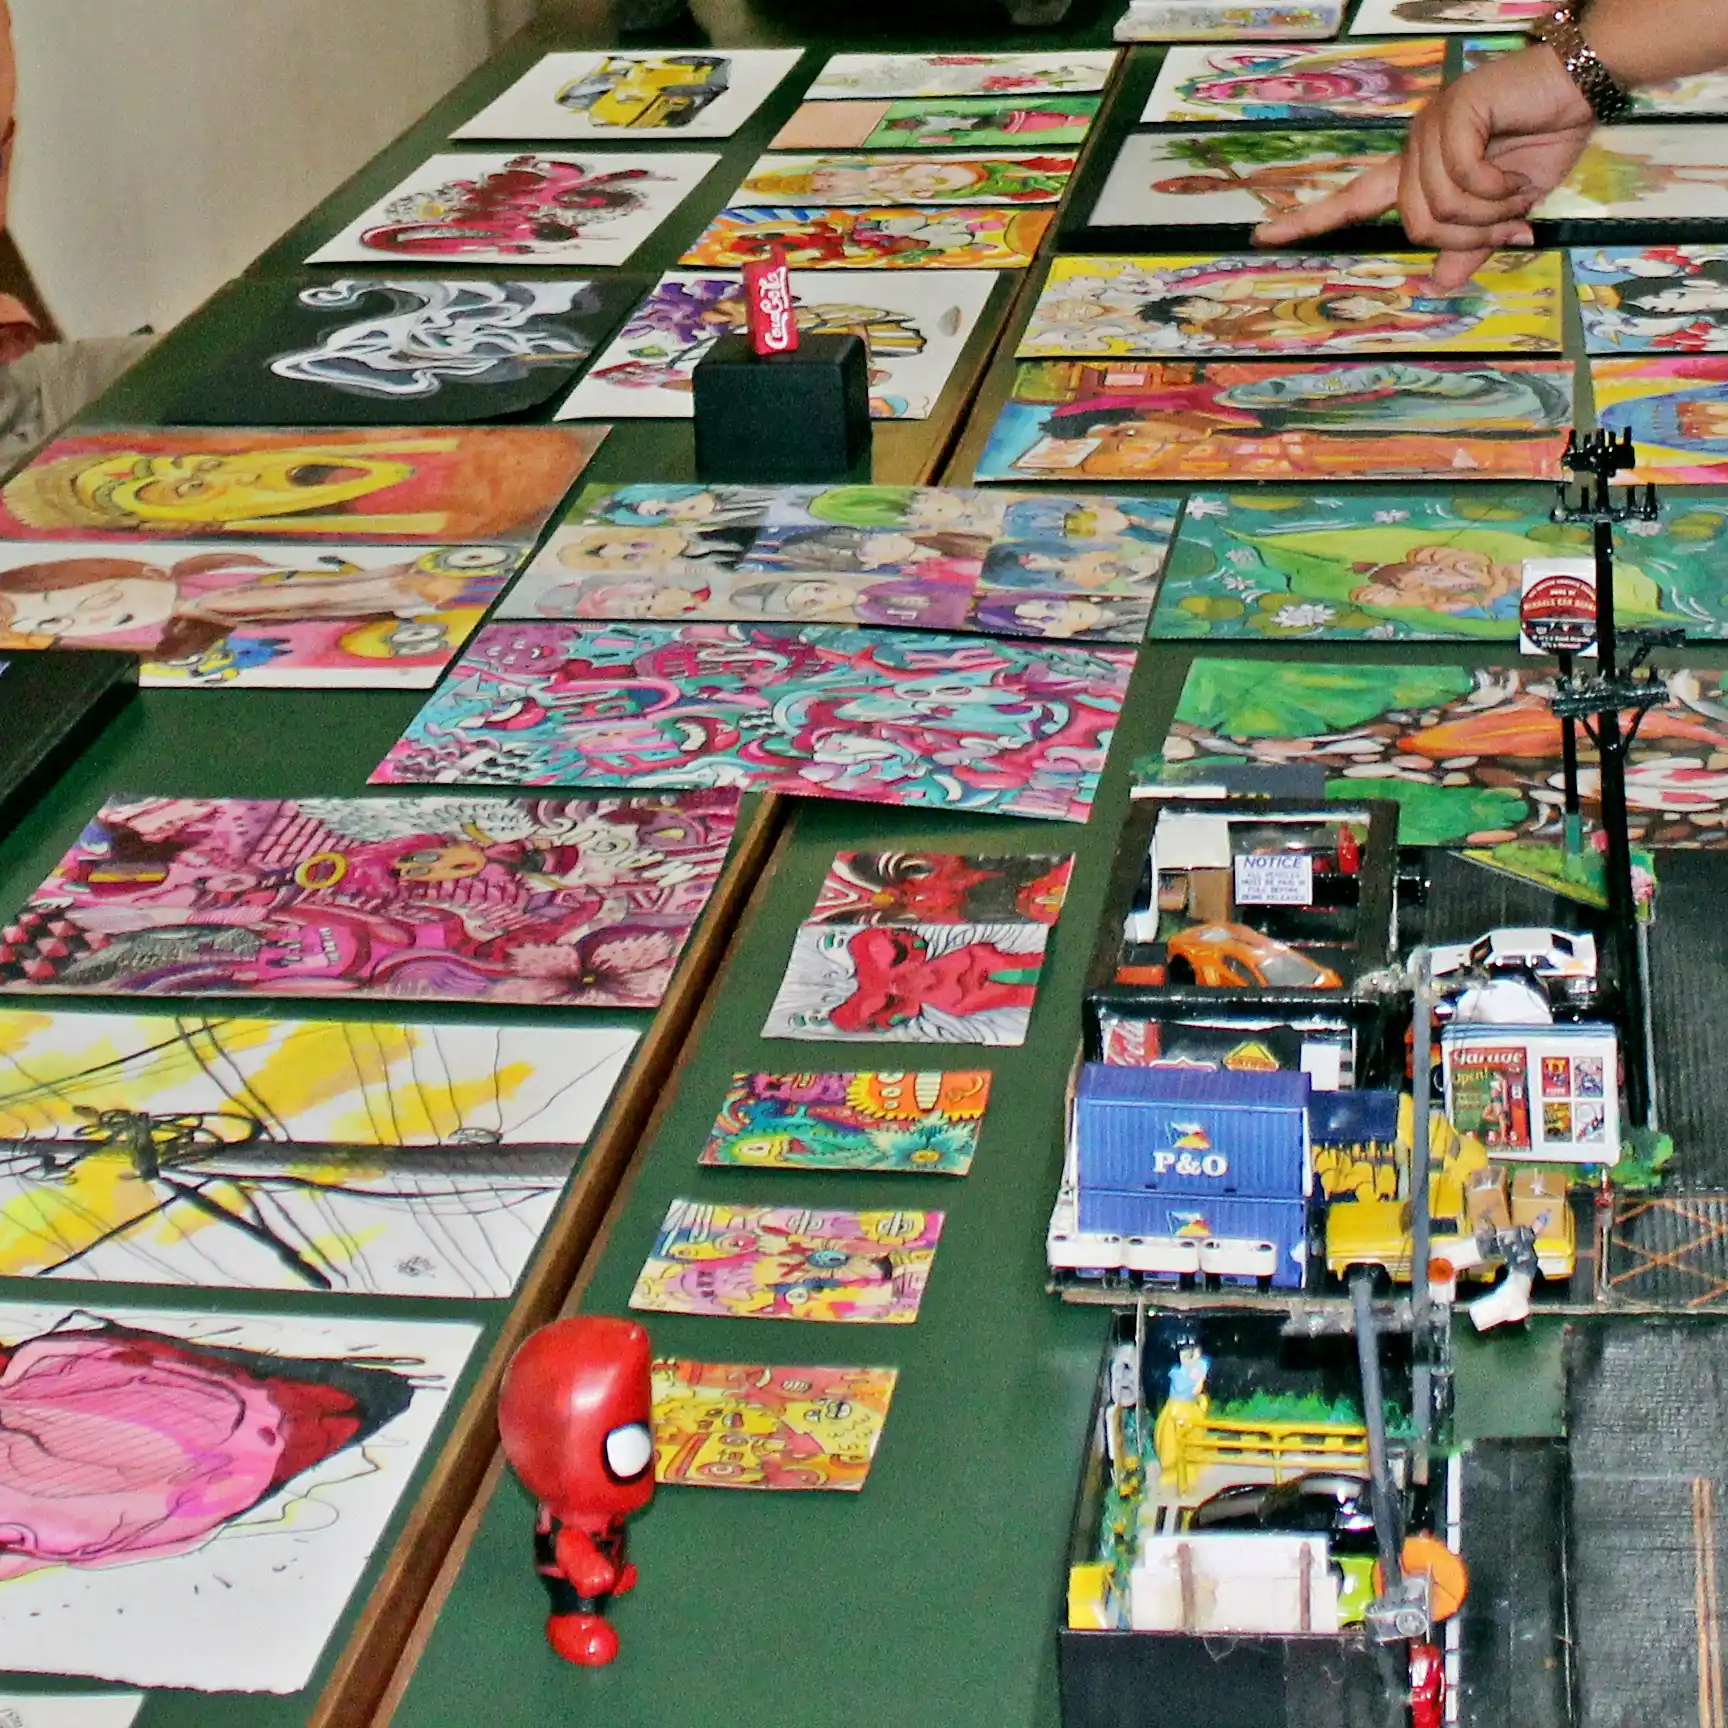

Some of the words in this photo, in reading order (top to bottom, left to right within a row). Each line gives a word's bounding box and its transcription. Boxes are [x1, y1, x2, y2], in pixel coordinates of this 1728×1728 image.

[1244, 856, 1302, 869] NOTICE
[1453, 1049, 1523, 1066] Garage
[1152, 1151, 1229, 1177] P&O
